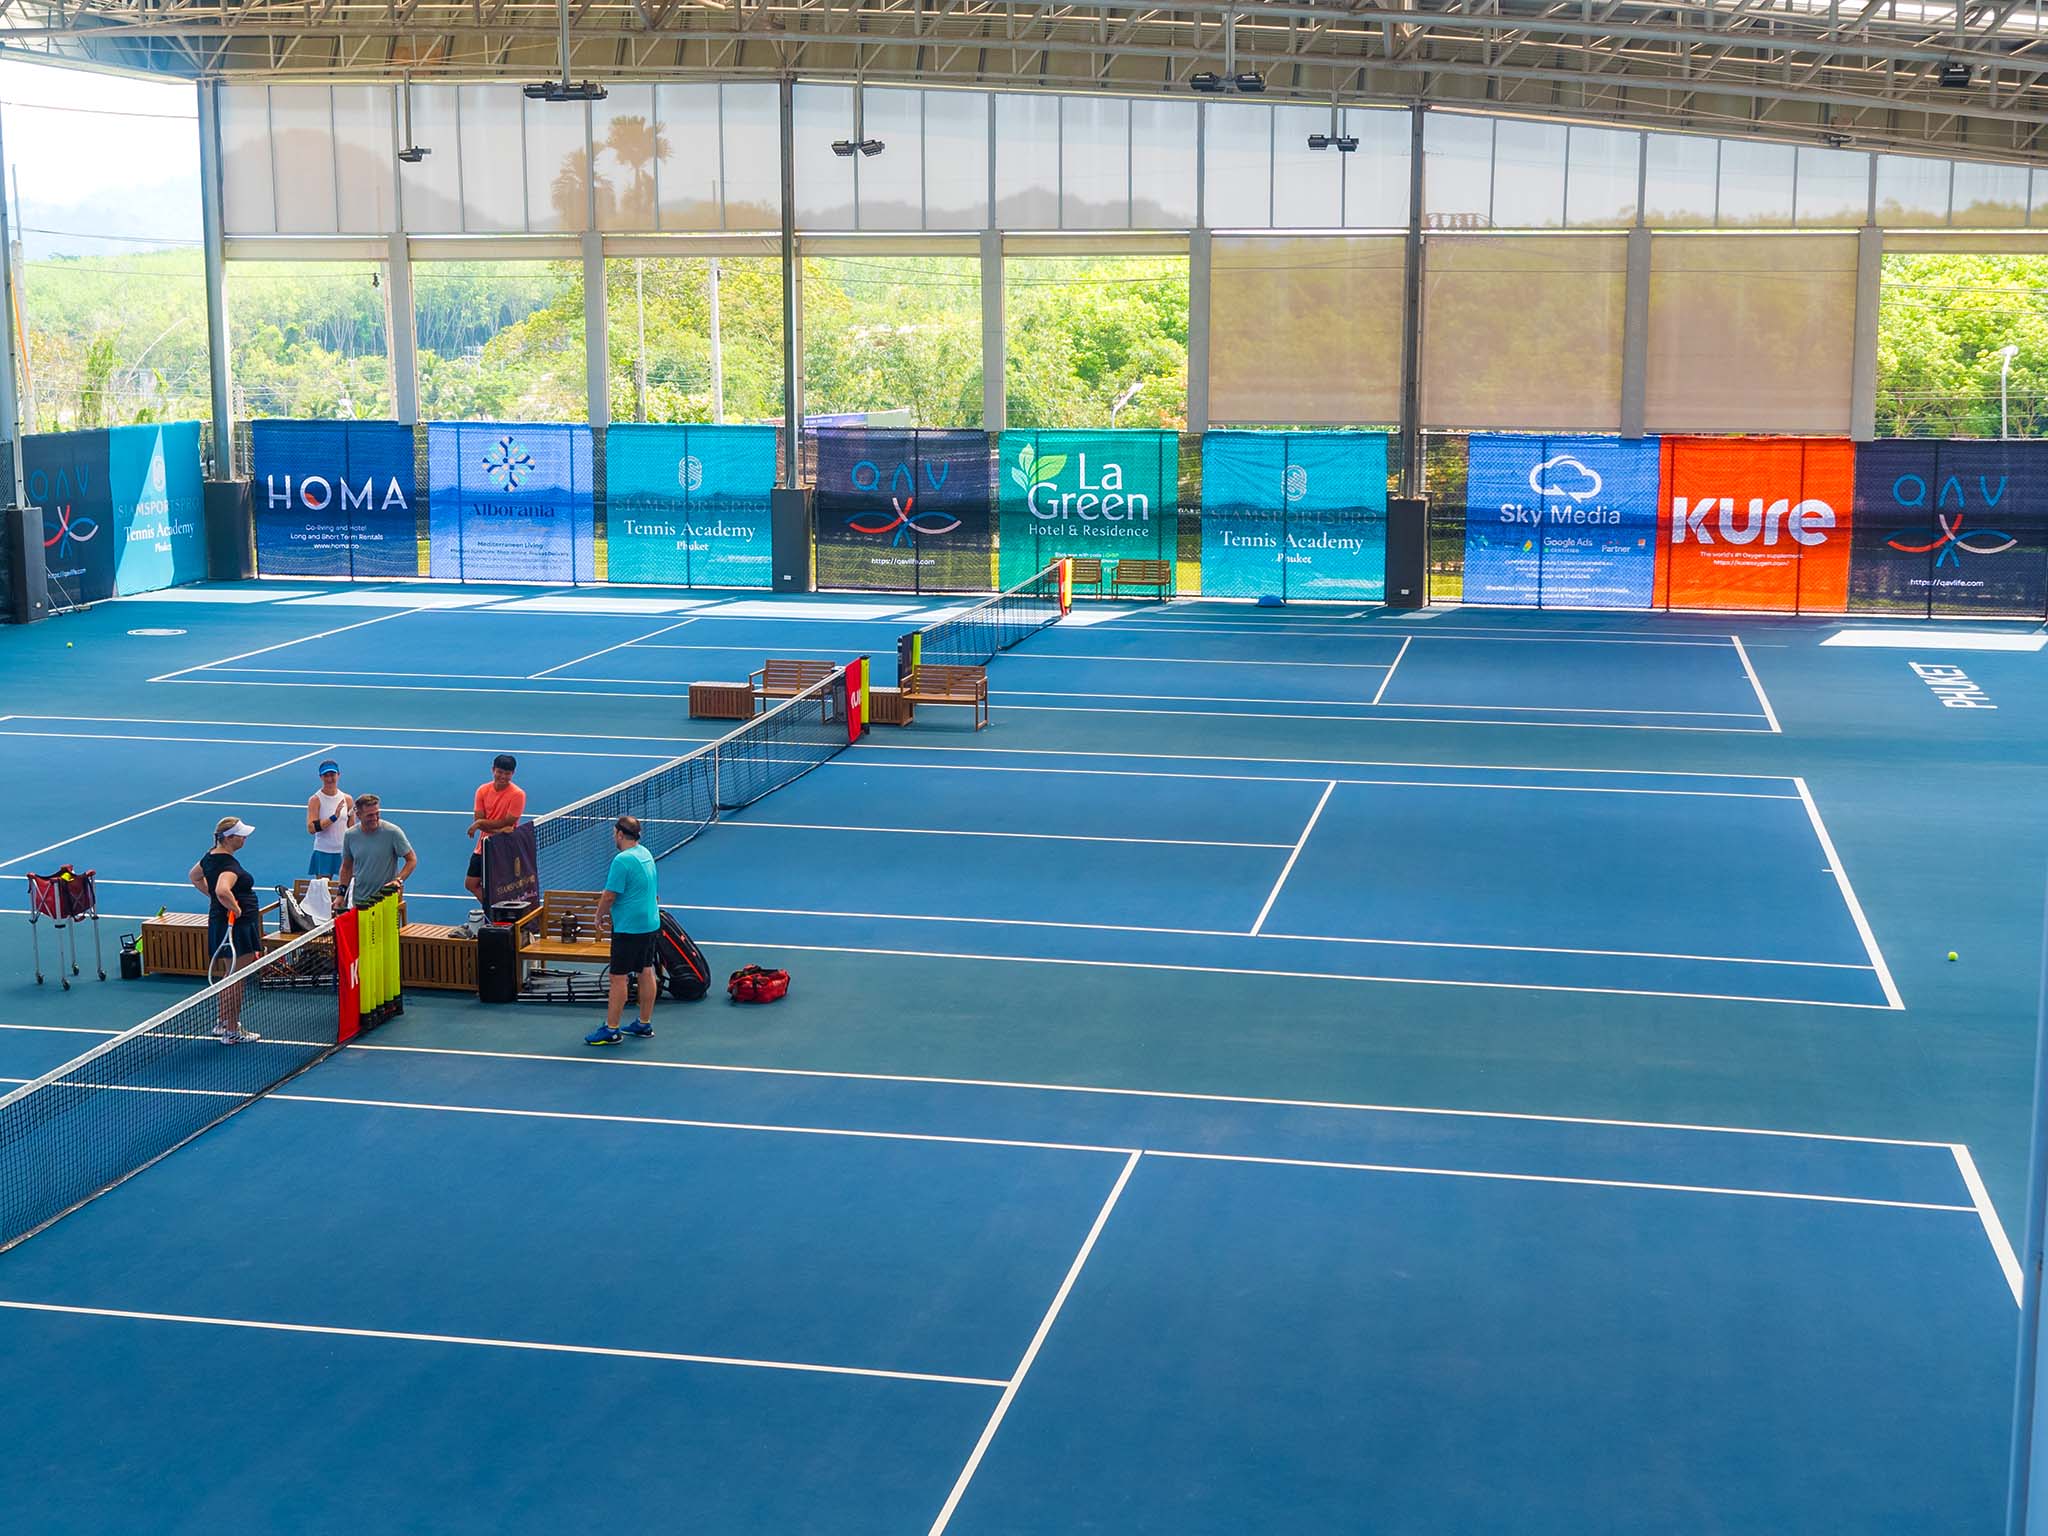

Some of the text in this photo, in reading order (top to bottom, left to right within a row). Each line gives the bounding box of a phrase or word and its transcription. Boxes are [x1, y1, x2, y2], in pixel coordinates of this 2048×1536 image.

[1079, 453, 1123, 490] La
[267, 475, 408, 511] HOMA
[1028, 482, 1149, 521] Green
[1500, 503, 1621, 527] Sky Media
[124, 519, 195, 542] Tennis Academy
[290, 533, 307, 541] Long
[624, 520, 756, 543] Tennis Academy
[1029, 524, 1149, 537] Hotel & Residence
[676, 541, 709, 551] Phuket
[1220, 530, 1364, 556] Tennis Academy
[1543, 537, 1594, 549] Google Ads
[1601, 545, 1631, 554] Partner
